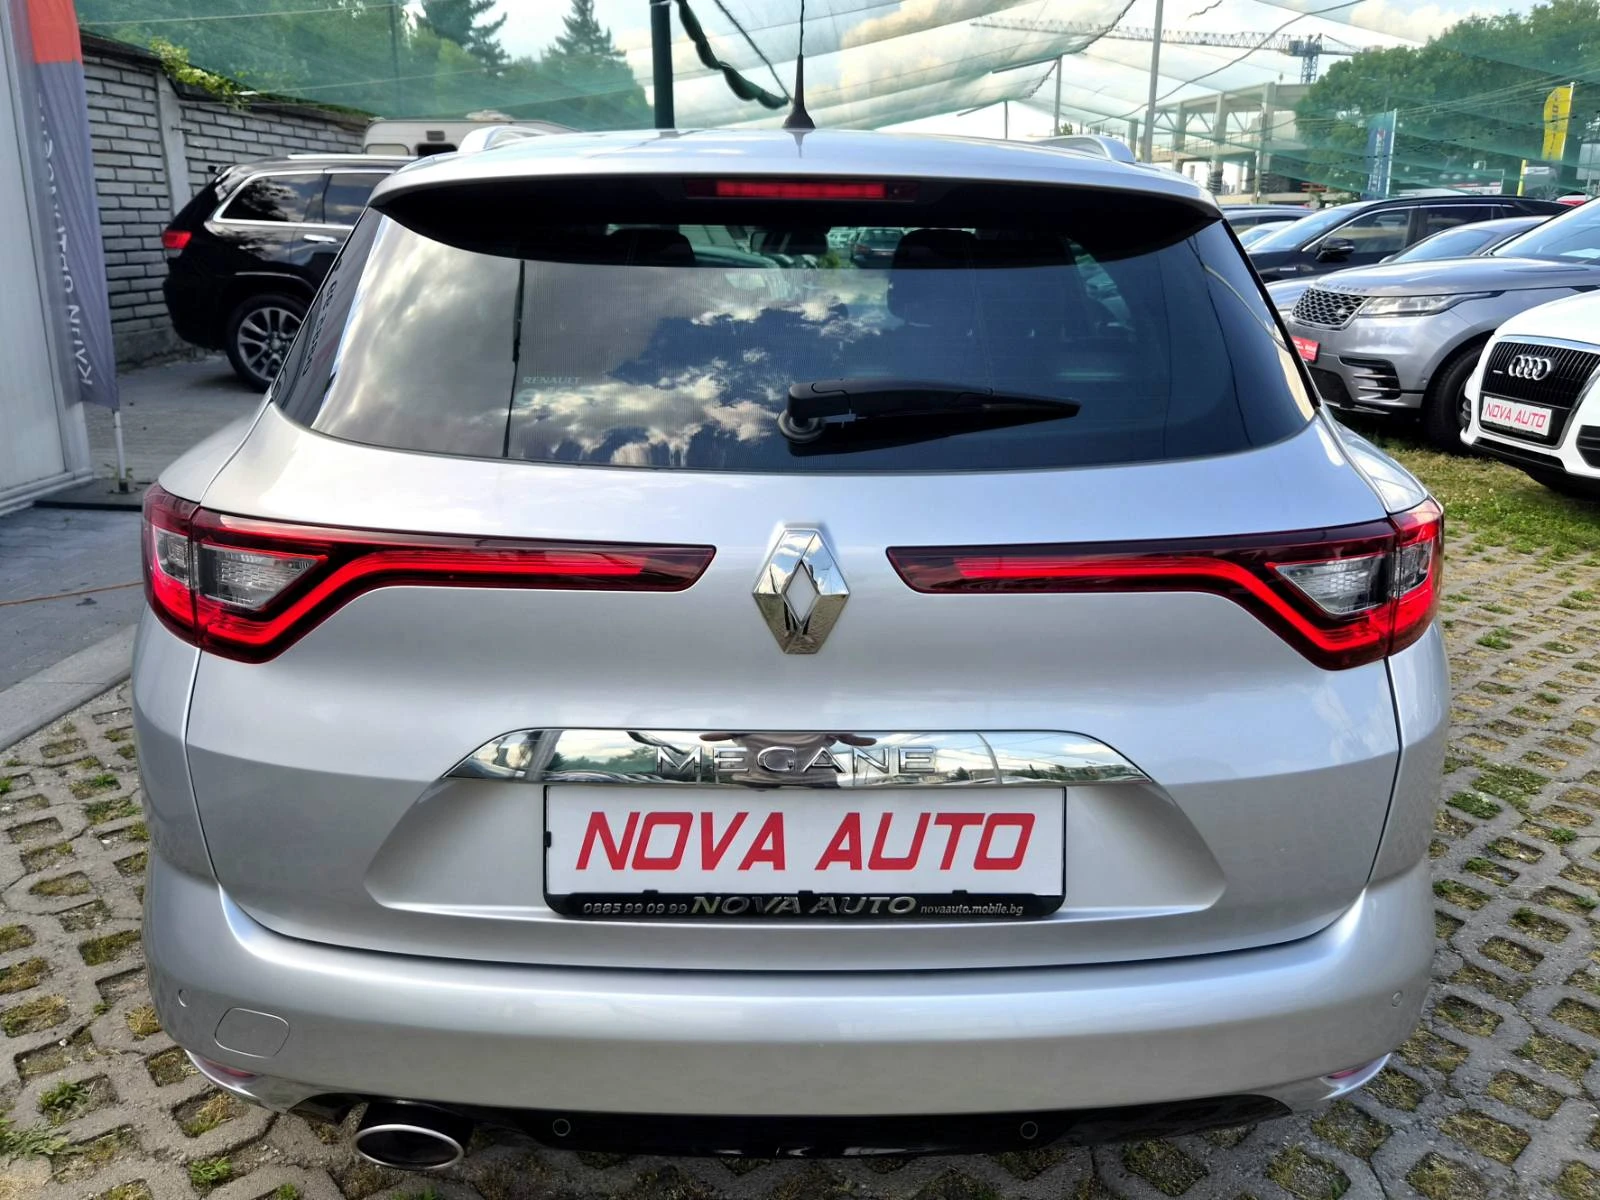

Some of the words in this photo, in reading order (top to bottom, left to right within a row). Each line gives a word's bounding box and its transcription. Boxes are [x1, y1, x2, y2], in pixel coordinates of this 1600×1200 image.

[522, 376, 582, 384] RENAULT
[1485, 403, 1512, 420] NOVA
[1514, 409, 1546, 428] AUTO
[656, 746, 937, 774] MEGANE
[575, 811, 786, 871] NOVA
[814, 811, 1035, 871] AUTO
[583, 902, 622, 914] 0885
[624, 902, 643, 914] 99
[646, 902, 665, 914] 09
[668, 902, 688, 914] 99
[691, 896, 802, 914] NOVA
[808, 896, 917, 914] AUTO
[920, 903, 1024, 916] novaauto.mobile.bg
